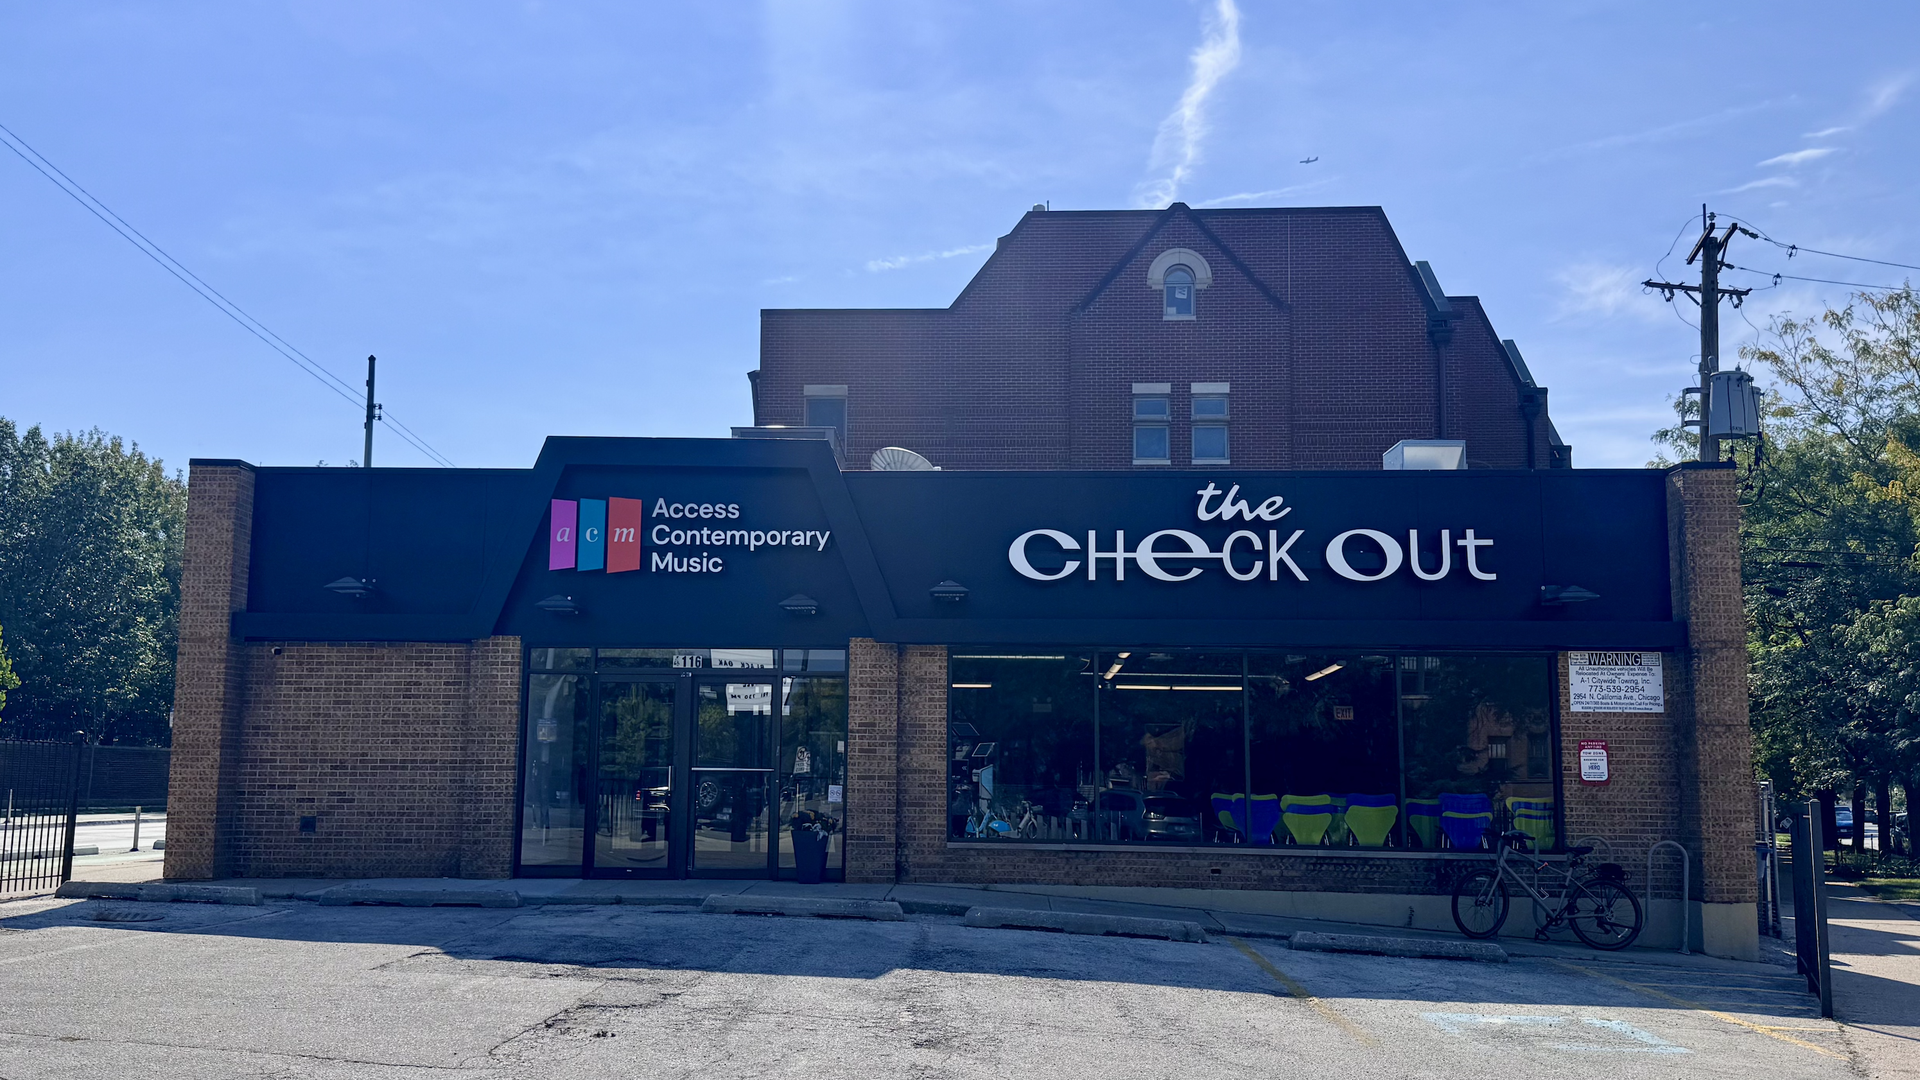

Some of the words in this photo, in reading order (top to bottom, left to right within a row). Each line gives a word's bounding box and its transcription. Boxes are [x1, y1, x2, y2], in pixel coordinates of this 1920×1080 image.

[651, 498, 740, 518] Access
[1197, 481, 1292, 522] the
[651, 525, 831, 551] Contemporary
[651, 552, 723, 573] Music
[1589, 653, 1641, 665] WARNING
[1588, 685, 1645, 693] 773-539-2954
[1637, 694, 1661, 702] Chicago
[1336, 708, 1352, 718] EXIT
